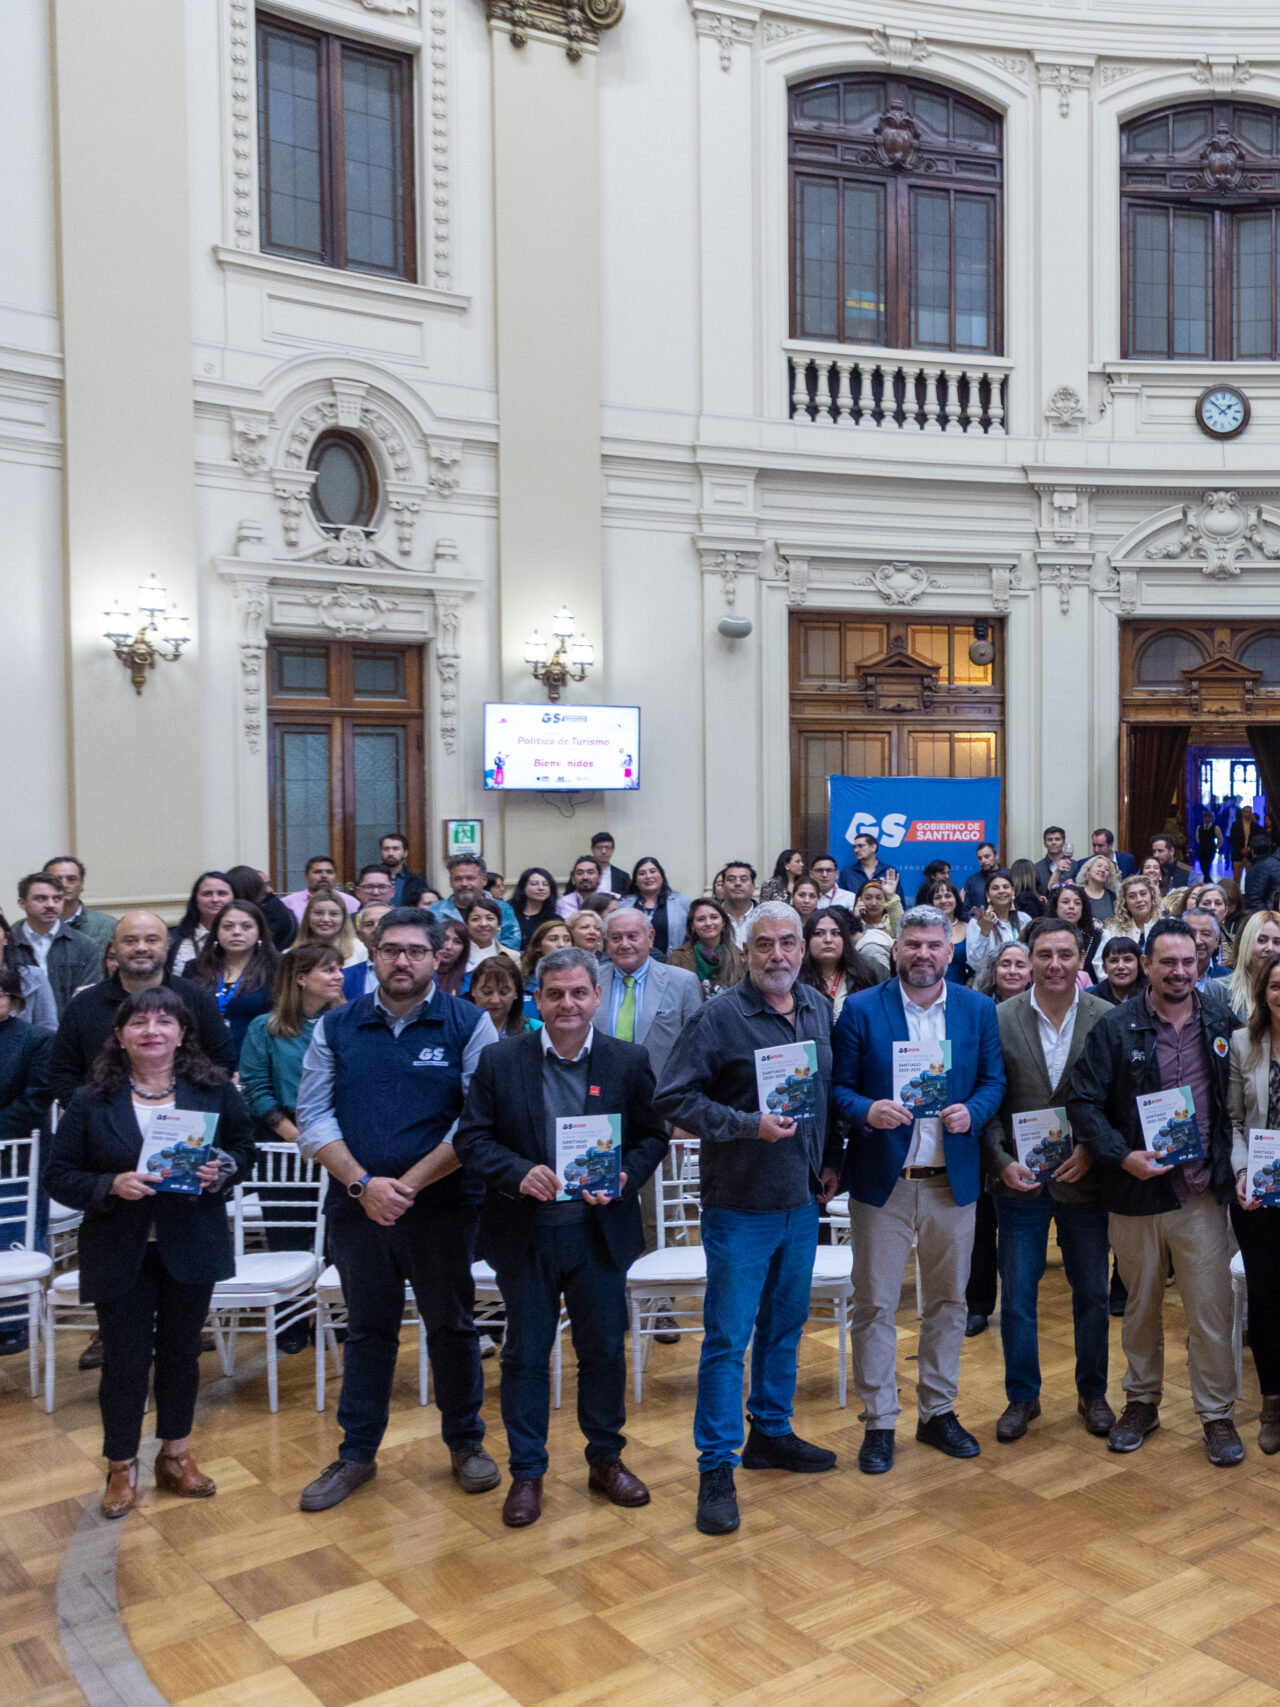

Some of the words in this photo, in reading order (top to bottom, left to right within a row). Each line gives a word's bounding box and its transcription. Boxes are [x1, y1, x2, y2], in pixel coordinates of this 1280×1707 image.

[541, 712, 561, 723] GS
[557, 737, 569, 746] de
[572, 736, 610, 746] Turismo
[533, 758, 594, 768] Bienvnidos
[844, 812, 907, 848] GS
[916, 822, 966, 831] GOBIERNO
[967, 822, 981, 831] DE
[916, 831, 980, 841] SANTIAGO
[418, 1047, 445, 1061] GS
